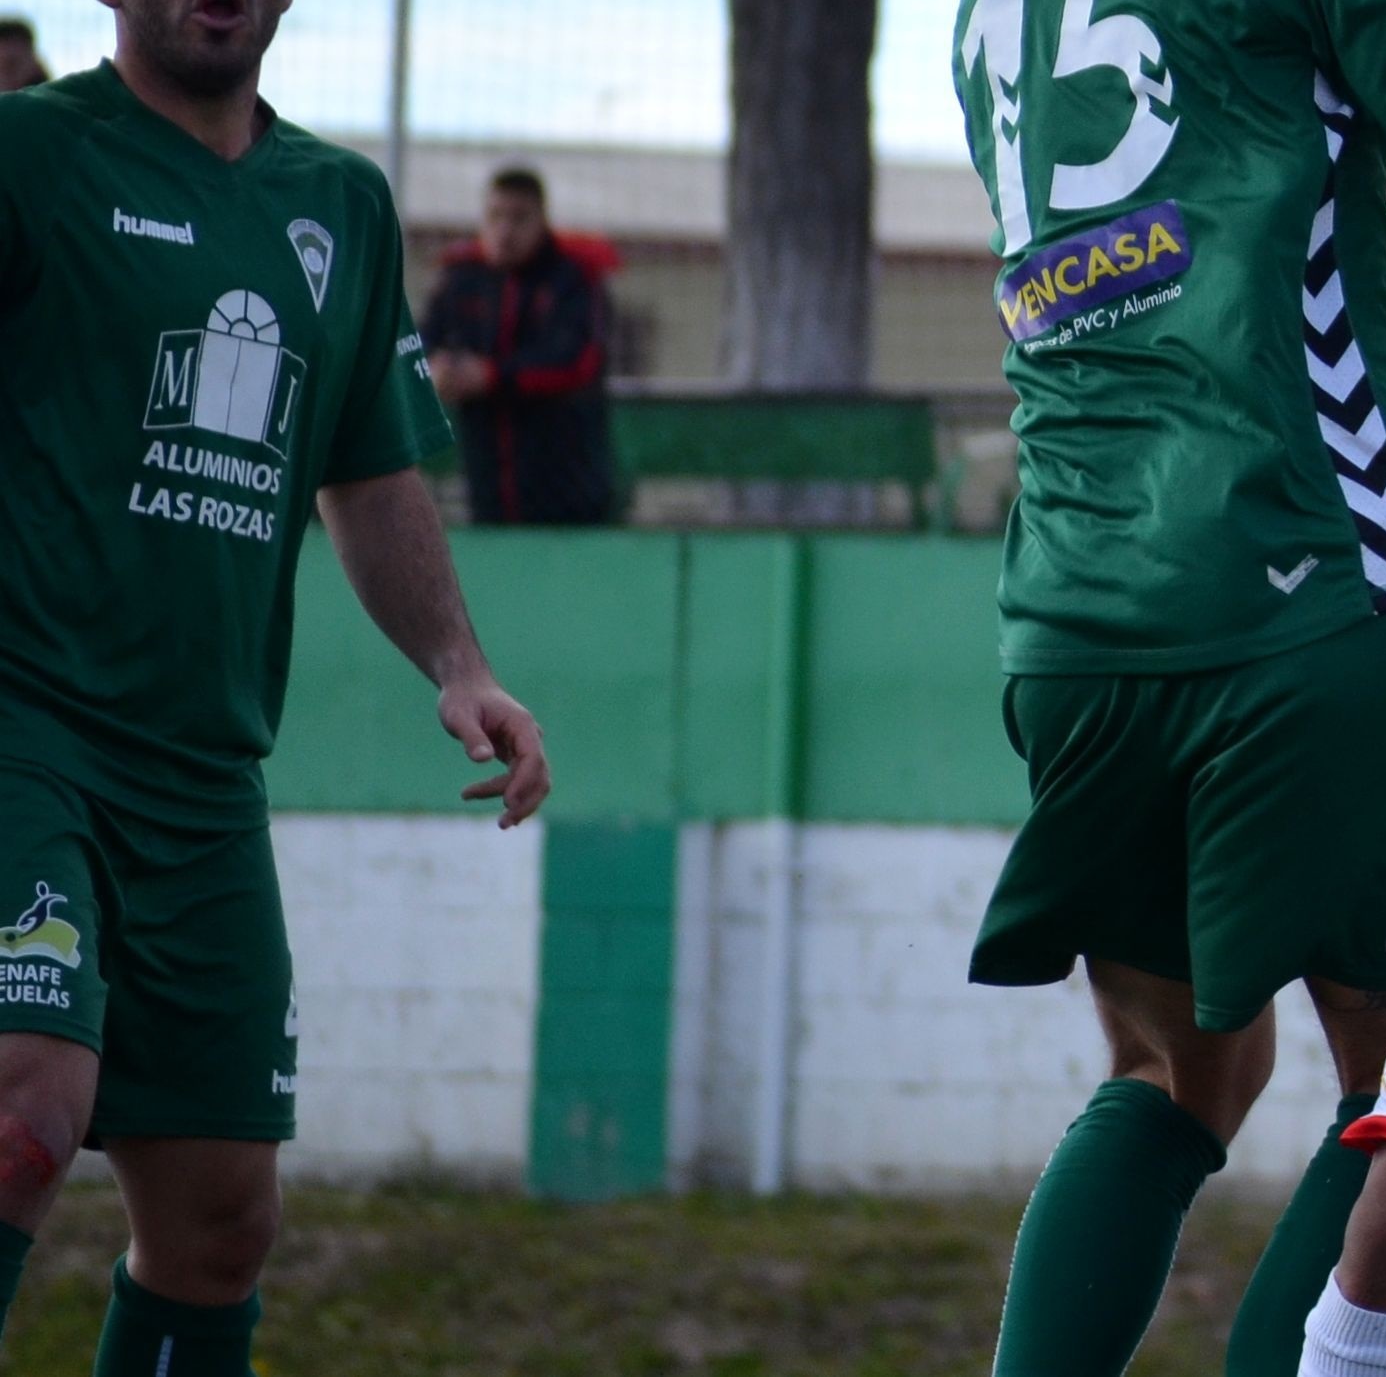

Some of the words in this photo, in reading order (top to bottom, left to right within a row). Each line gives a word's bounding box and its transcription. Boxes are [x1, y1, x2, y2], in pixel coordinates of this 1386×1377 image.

[113, 207, 195, 245] hummel
[1000, 222, 1182, 329] VENCASA
[1073, 308, 1106, 337] PVC
[1108, 309, 1120, 329] y
[1122, 283, 1183, 319] Aluminio
[153, 346, 195, 410] M
[277, 375, 298, 434] J
[143, 440, 283, 495] ALUMINIOS
[128, 482, 194, 522] LAS
[198, 495, 276, 541] ROZAS
